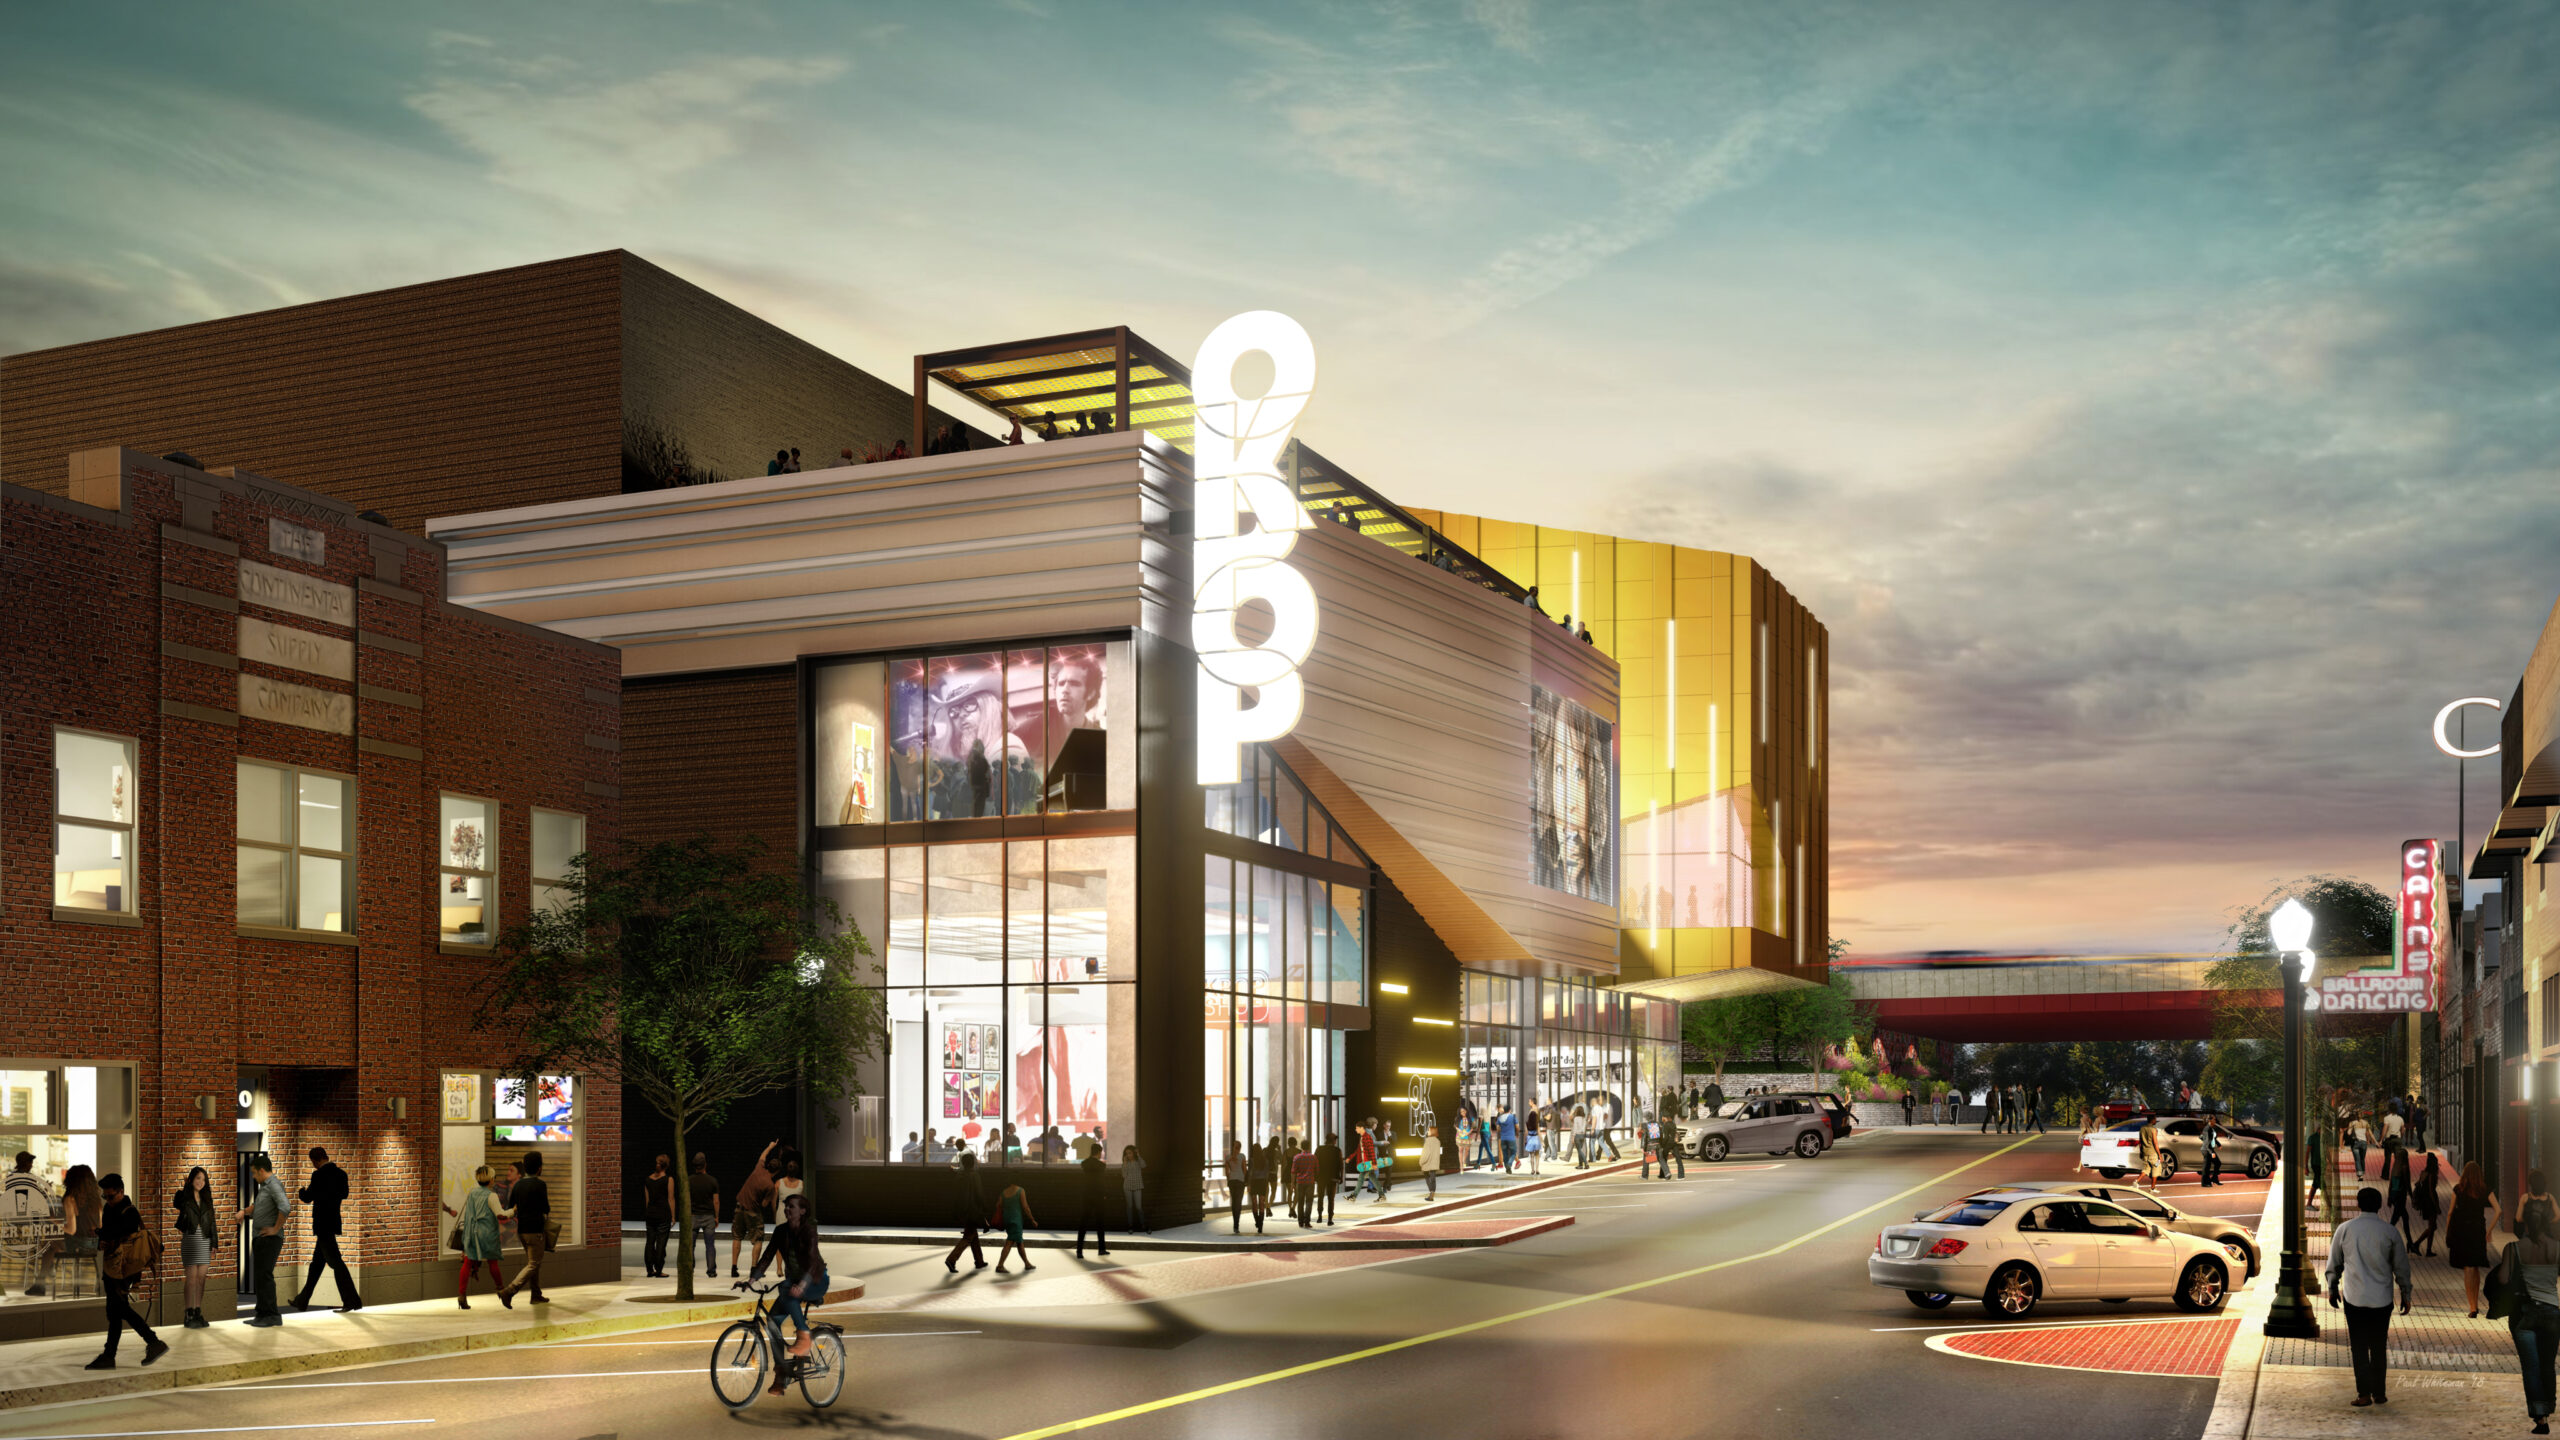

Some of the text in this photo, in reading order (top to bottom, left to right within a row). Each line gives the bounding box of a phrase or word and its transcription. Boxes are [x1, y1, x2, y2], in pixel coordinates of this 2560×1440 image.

[267, 631, 321, 665] SUPPLY
[257, 686, 331, 720] COMPANY
[2405, 848, 2431, 972] CAINS
[2323, 977, 2424, 993] BALLROOM
[2324, 993, 2428, 1011] DANCING
[21, 1222, 65, 1238] CIRCLE
